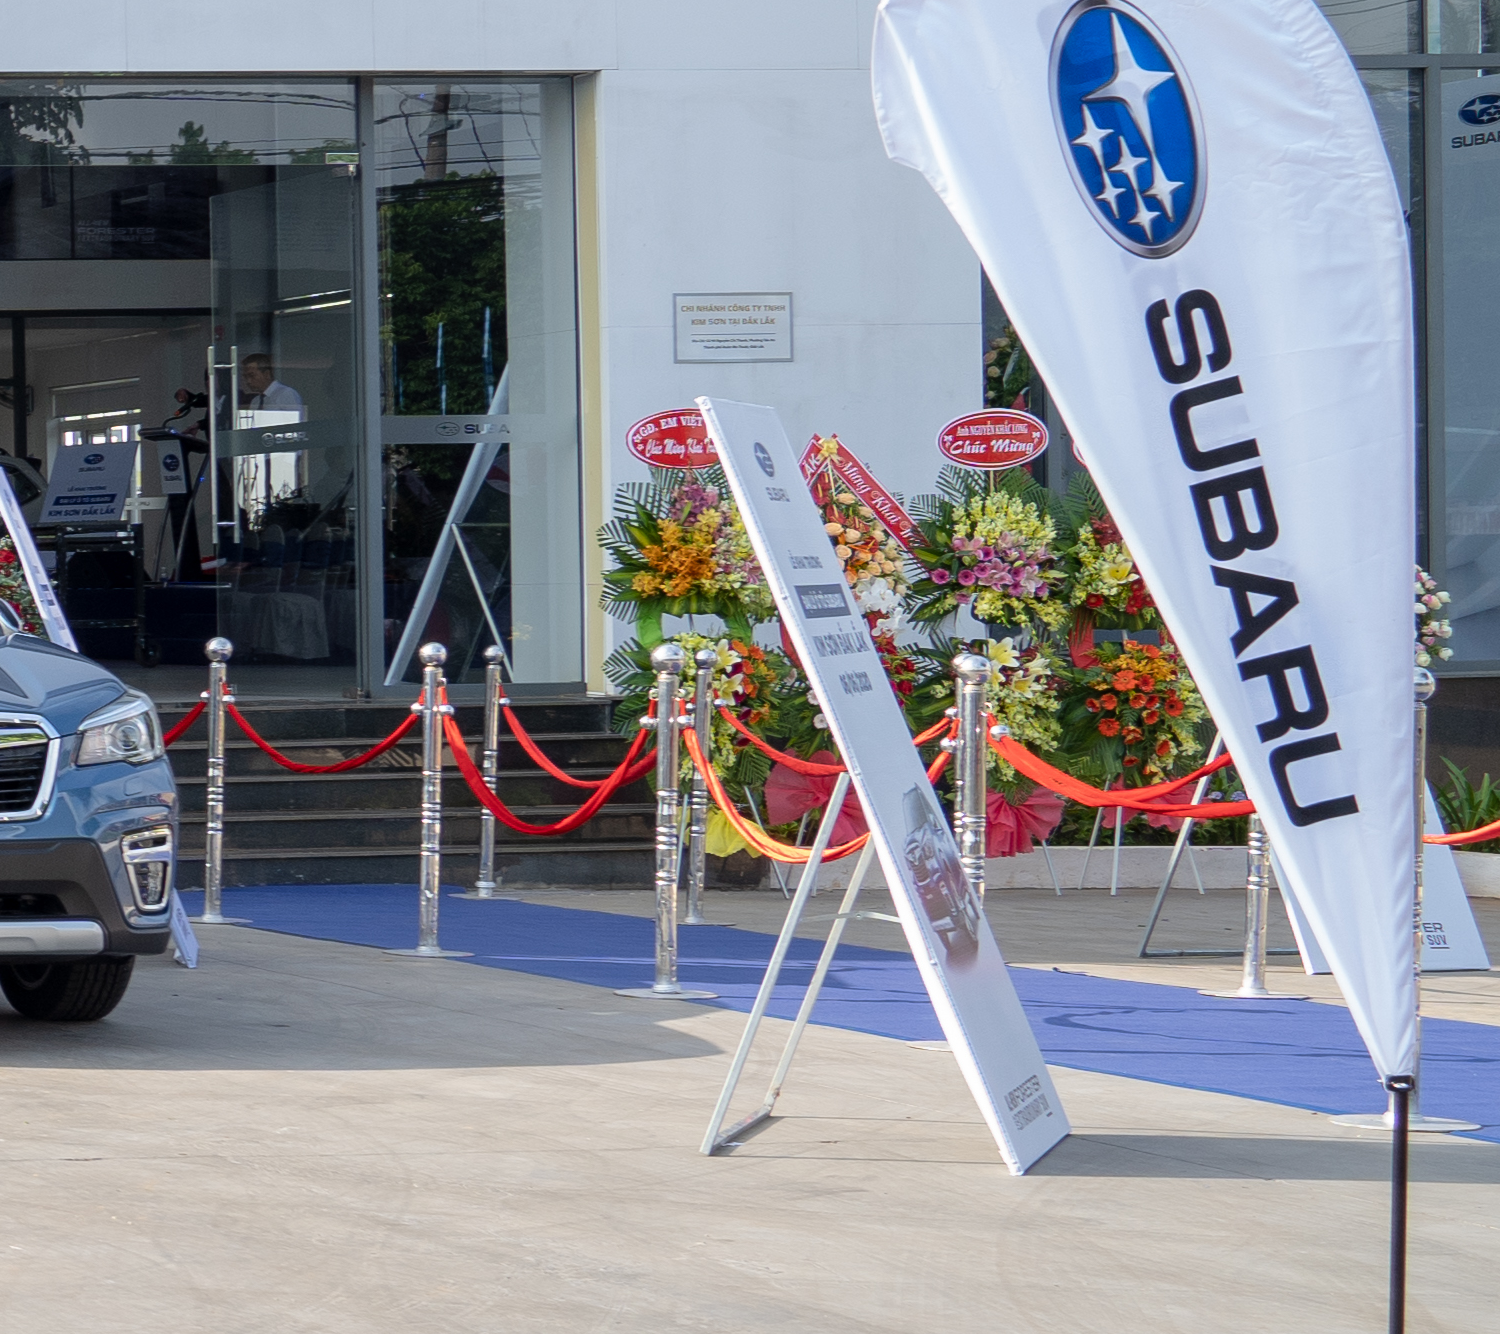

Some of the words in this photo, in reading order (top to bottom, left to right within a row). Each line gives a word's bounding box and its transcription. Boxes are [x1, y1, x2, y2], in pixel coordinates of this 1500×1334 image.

[1451, 130, 1500, 149] SUBA
[751, 304, 762, 312] TY
[659, 417, 678, 429] EM
[950, 439, 988, 454] Chúc
[990, 438, 1034, 454] Mừng
[1145, 288, 1360, 827] SUBARU
[1426, 934, 1448, 946] SUV
